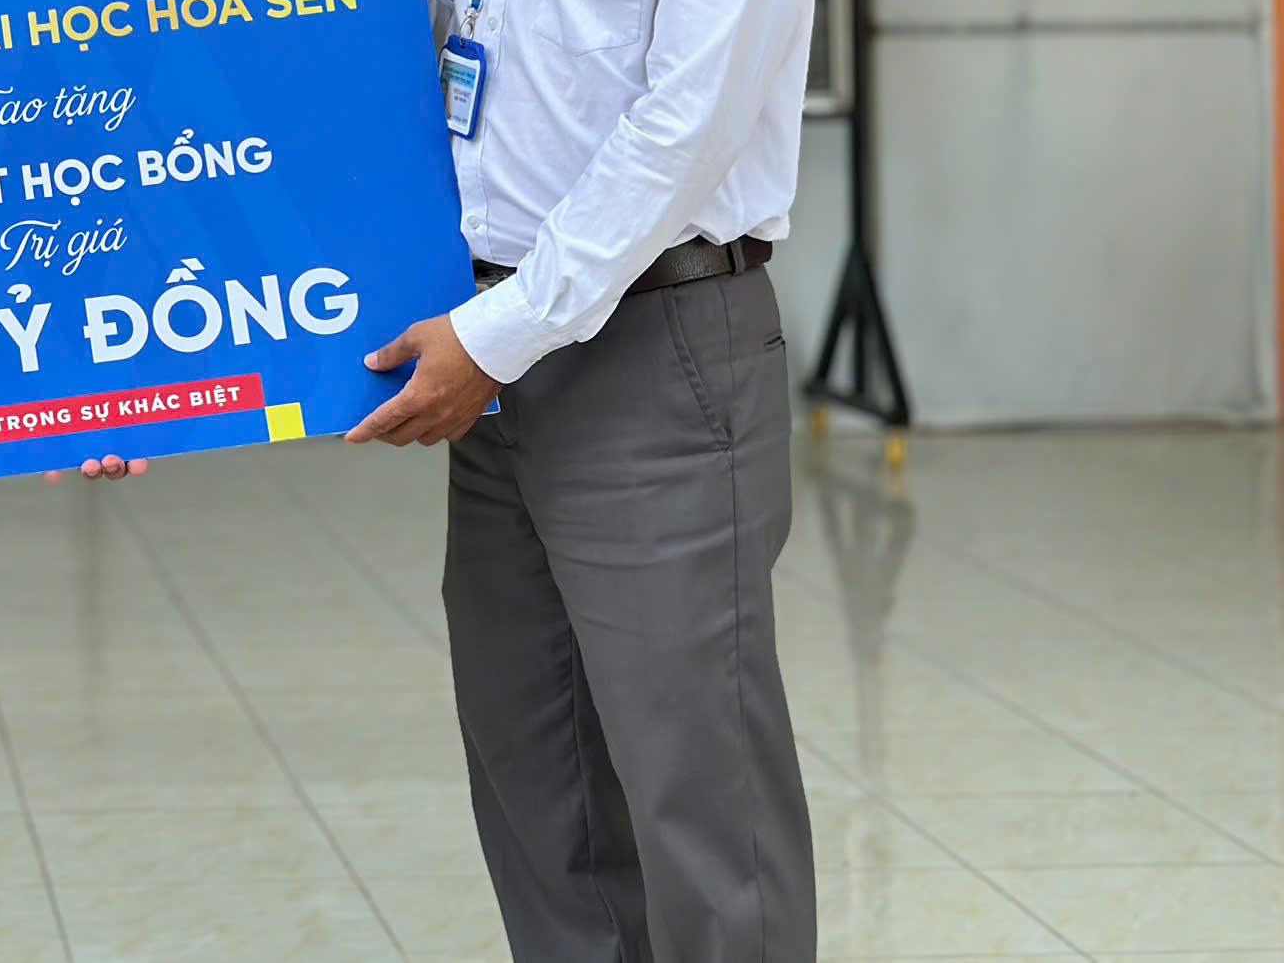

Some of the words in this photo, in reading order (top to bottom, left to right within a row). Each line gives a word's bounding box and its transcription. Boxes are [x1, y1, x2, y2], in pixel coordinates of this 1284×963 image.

[27, 1, 133, 52] HỌC
[50, 83, 137, 132] tặng
[21, 154, 127, 207] HỌC
[137, 128, 274, 187] BỔNG
[0, 219, 63, 272] Trị
[60, 217, 129, 276] giá
[83, 257, 359, 365] ĐỒNG
[79, 400, 110, 423] SỰ
[118, 393, 181, 416] KHÁC
[189, 384, 242, 407] BIỆT
